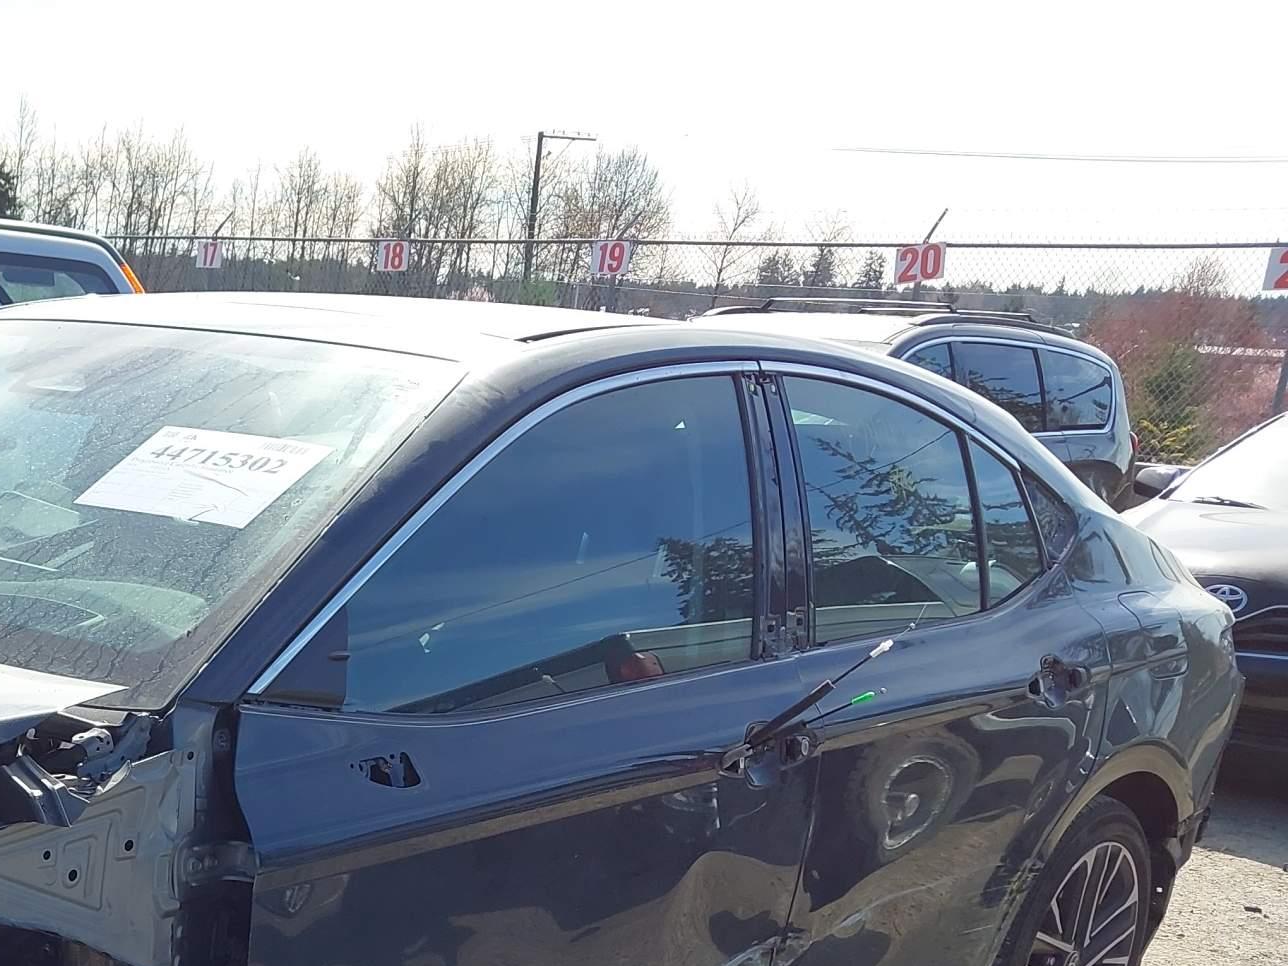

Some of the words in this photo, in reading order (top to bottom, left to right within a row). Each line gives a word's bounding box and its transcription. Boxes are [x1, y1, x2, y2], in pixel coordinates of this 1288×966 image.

[201, 242, 218, 268] 17
[383, 242, 405, 270] 18
[599, 242, 625, 273] 19
[898, 244, 942, 283] 20
[150, 444, 288, 475] 44715302
